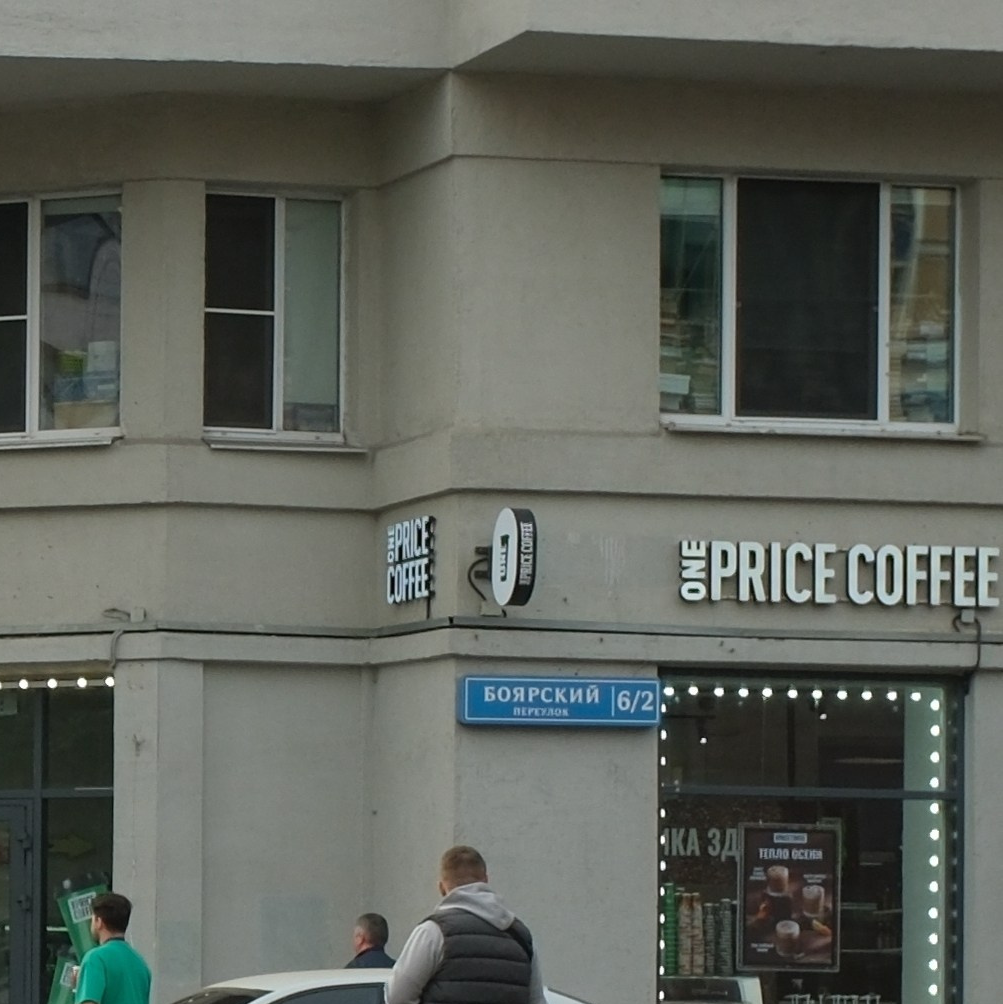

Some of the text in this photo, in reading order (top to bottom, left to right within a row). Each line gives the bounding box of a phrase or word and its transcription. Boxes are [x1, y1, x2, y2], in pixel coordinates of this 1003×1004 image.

[395, 515, 429, 561] PRICE
[387, 557, 429, 605] COFFEE
[680, 539, 999, 608] ONE PRICE COFFEE
[483, 685, 655, 713] БОЯРСКИЙ 6/2
[512, 707, 570, 718] ПЕРЕУЛОК
